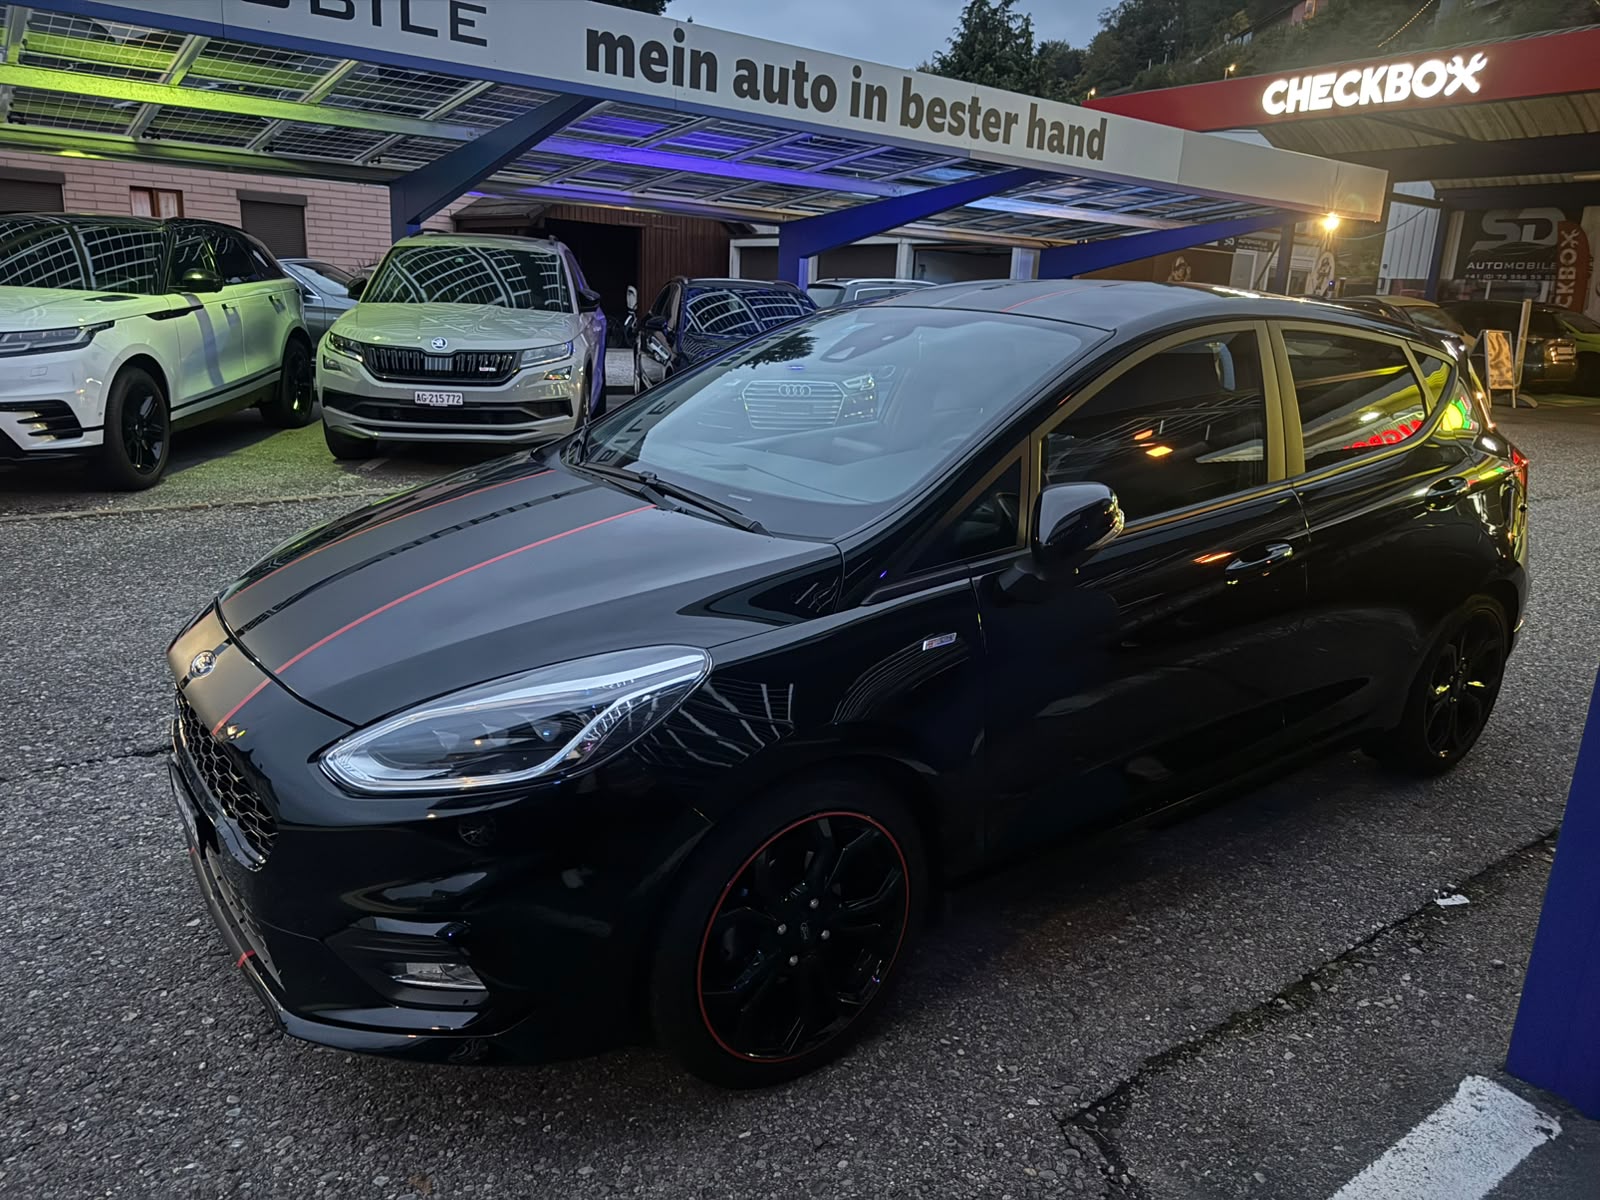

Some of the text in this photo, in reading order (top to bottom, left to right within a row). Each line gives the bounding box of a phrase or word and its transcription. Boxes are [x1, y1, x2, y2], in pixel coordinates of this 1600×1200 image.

[586, 28, 1108, 160] mein auto in bester hand
[1262, 52, 1488, 115] CHECKBOX
[1470, 207, 1567, 253] SD
